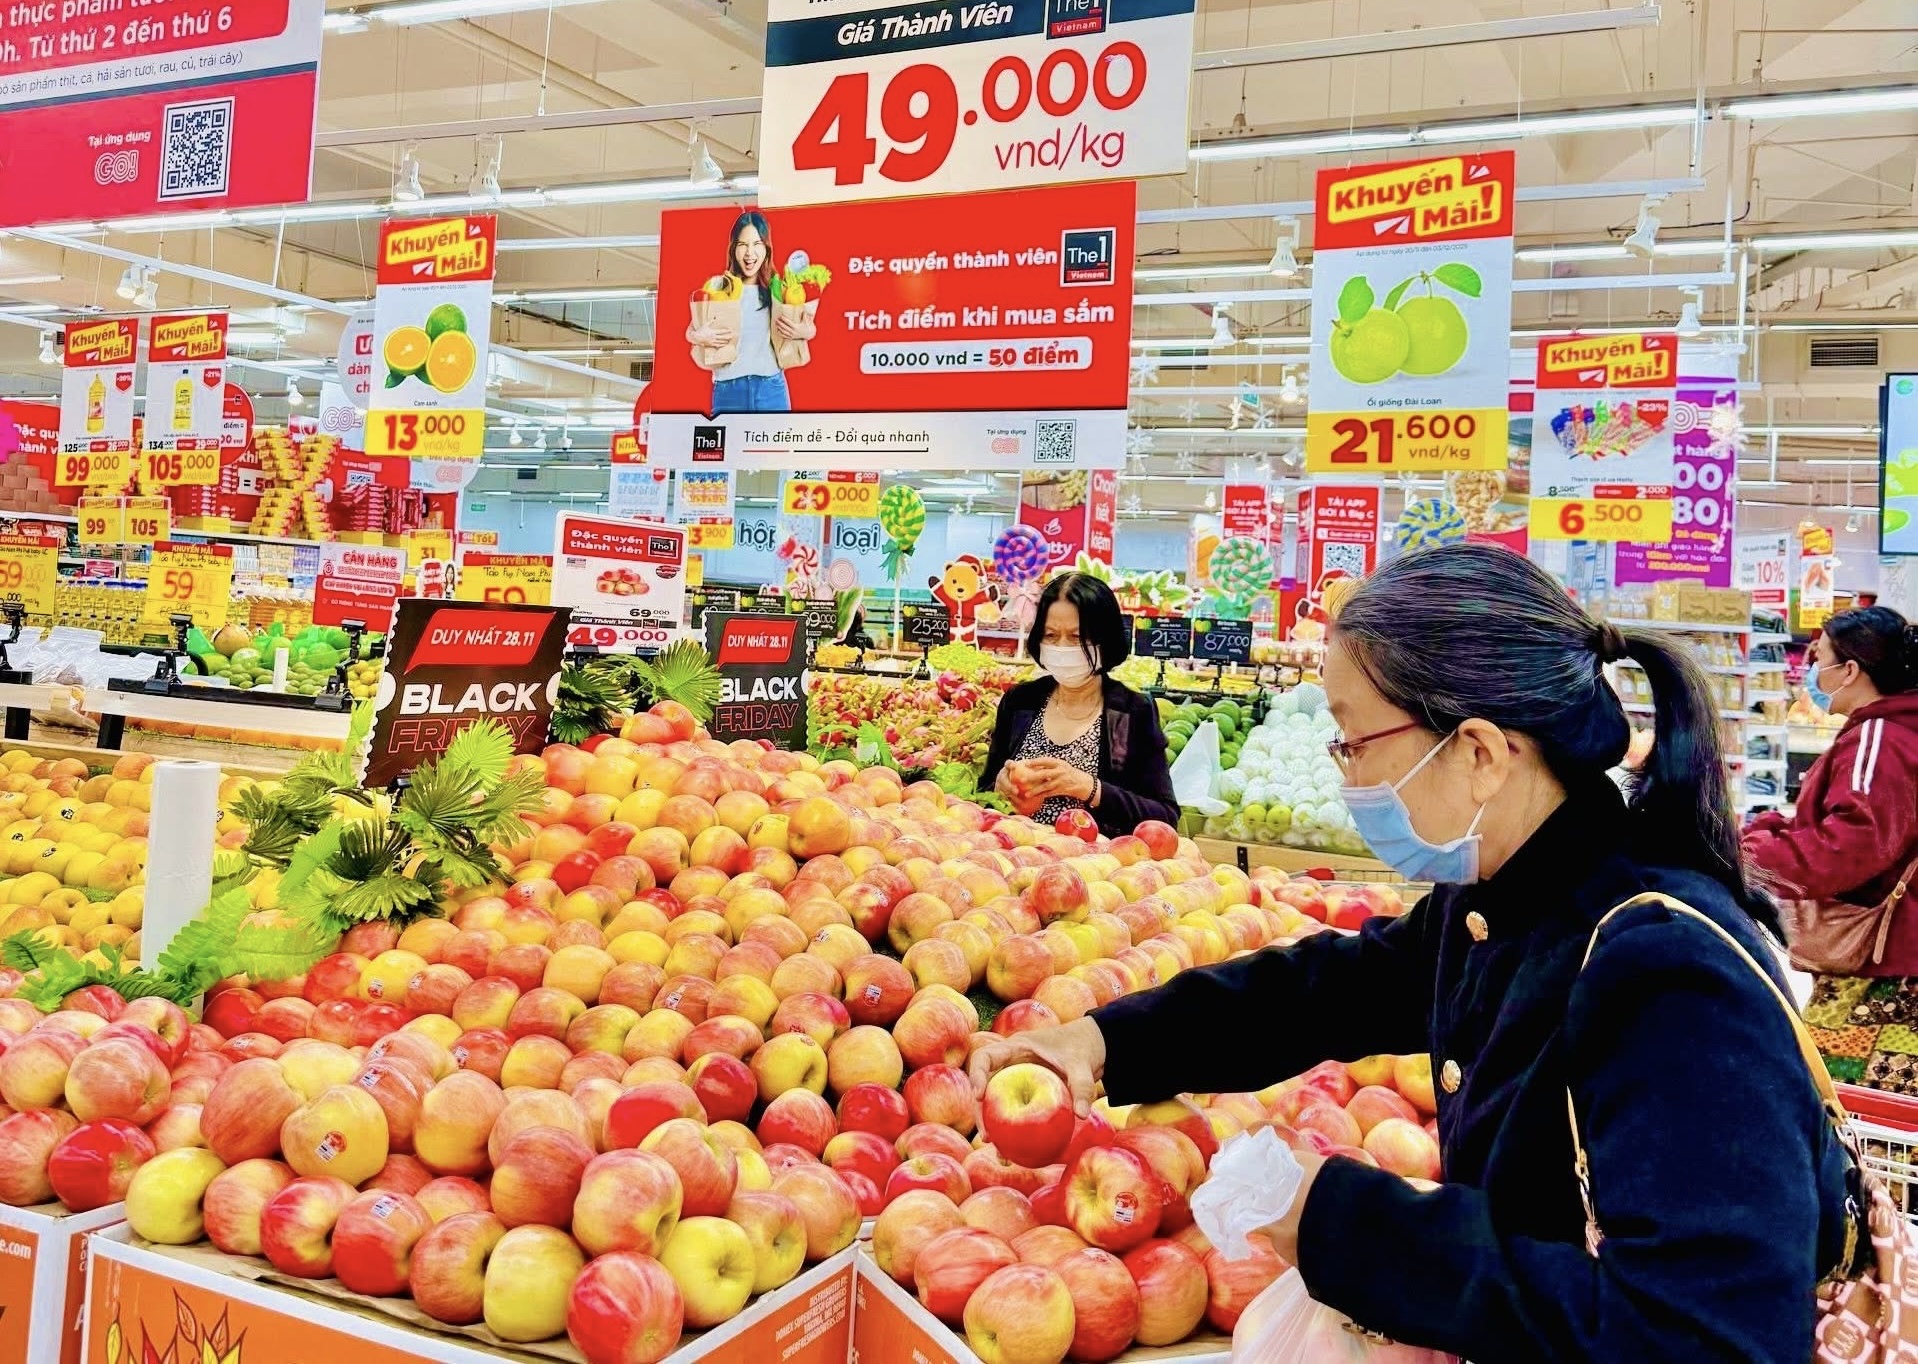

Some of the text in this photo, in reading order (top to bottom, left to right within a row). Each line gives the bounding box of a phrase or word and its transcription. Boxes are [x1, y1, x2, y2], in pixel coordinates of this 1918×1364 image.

[10, 2, 56, 27] thực
[837, 1, 1014, 46] Giá Thành Viên
[30, 33, 55, 59] Từ
[61, 28, 97, 55] thứ
[102, 25, 116, 49] 2
[123, 16, 164, 45] đến
[173, 10, 211, 38] thứ
[217, 6, 232, 31] 6
[1055, 21, 1097, 34] Vietnam
[200, 54, 216, 68] trái
[792, 41, 1147, 186] 49.000
[88, 134, 103, 149] Tại
[125, 130, 151, 145] dụng
[994, 121, 1124, 170] vnd/kg
[94, 149, 139, 185] GO!
[1335, 168, 1453, 212] Khuyến
[1422, 184, 1495, 232] Mãi!
[391, 226, 460, 256] Khuyến
[441, 240, 483, 274] Mãi!
[848, 255, 884, 277] Đặc
[953, 249, 1010, 270] thành
[1015, 247, 1057, 266] viên
[1070, 270, 1105, 280] Vietnam
[844, 298, 1114, 331] Tích điểm khi mua sắm
[71, 325, 116, 349] Khuyến
[157, 319, 204, 343] Khuyến
[871, 340, 1079, 367] 10.000 vnd = 50 điểm
[1551, 338, 1635, 365] Khuyến
[348, 362, 371, 376] dàn
[356, 380, 370, 394] ch
[1378, 397, 1403, 407] giống
[1421, 397, 1442, 405] Loan
[322, 406, 364, 431] GO
[384, 414, 465, 451] 13.000
[423, 436, 460, 453] vnd/kg
[744, 430, 769, 443] Tích
[772, 427, 803, 443] điểm
[807, 428, 822, 443] dễ
[835, 427, 858, 443] Đổi
[861, 429, 885, 445] quà
[889, 429, 930, 443] nhanh
[1330, 414, 1476, 463] 21.600
[1409, 445, 1471, 460] vnd/kg
[65, 456, 120, 482] 99.000
[148, 454, 215, 480] 105.000
[1346, 499, 1367, 508] APP
[86, 518, 106, 535] 99
[131, 518, 158, 536] 105
[1559, 503, 1643, 535] 6.500
[571, 529, 598, 540] Đặc
[836, 523, 878, 554] loại
[367, 551, 398, 568] HÀNG
[489, 552, 528, 565] KHUYẾN
[615, 544, 642, 555] viên
[1757, 561, 1784, 584] 10%
[431, 624, 535, 647] DUY NHẤT 28.11
[567, 626, 668, 647] 49.000
[727, 632, 788, 649] DUY NHẤT 28.11
[399, 682, 542, 715] BLACK
[718, 677, 799, 703] BLACK
[716, 703, 799, 733] FRIDAY
[387, 715, 537, 754] FRIY
